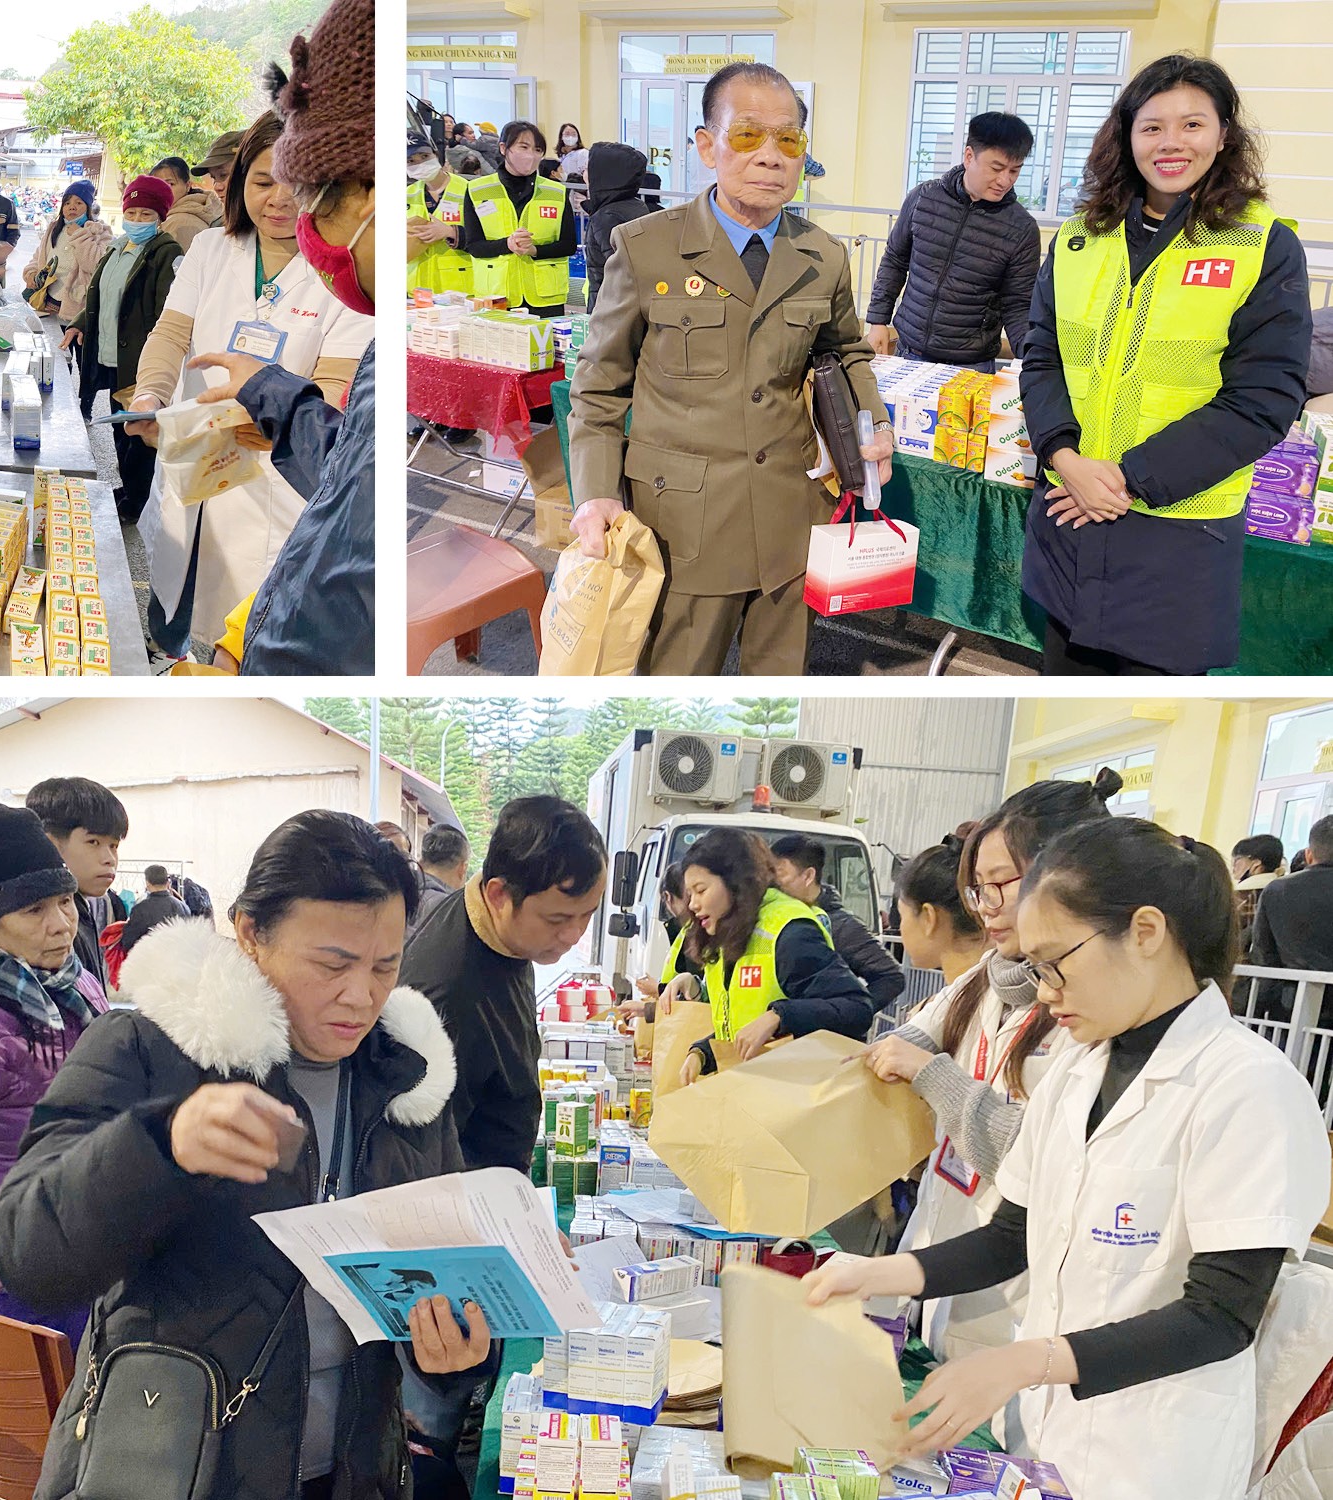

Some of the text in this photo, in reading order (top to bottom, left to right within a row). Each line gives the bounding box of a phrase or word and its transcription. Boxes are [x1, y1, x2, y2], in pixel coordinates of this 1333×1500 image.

[421, 48, 443, 58] KHÁM
[445, 47, 476, 59] CHUYÊN
[478, 49, 501, 60] KHOA
[687, 56, 707, 65] KHÁM
[650, 146, 672, 167] P.5
[999, 425, 1027, 444] Odesol
[995, 459, 1023, 477] Odesol
